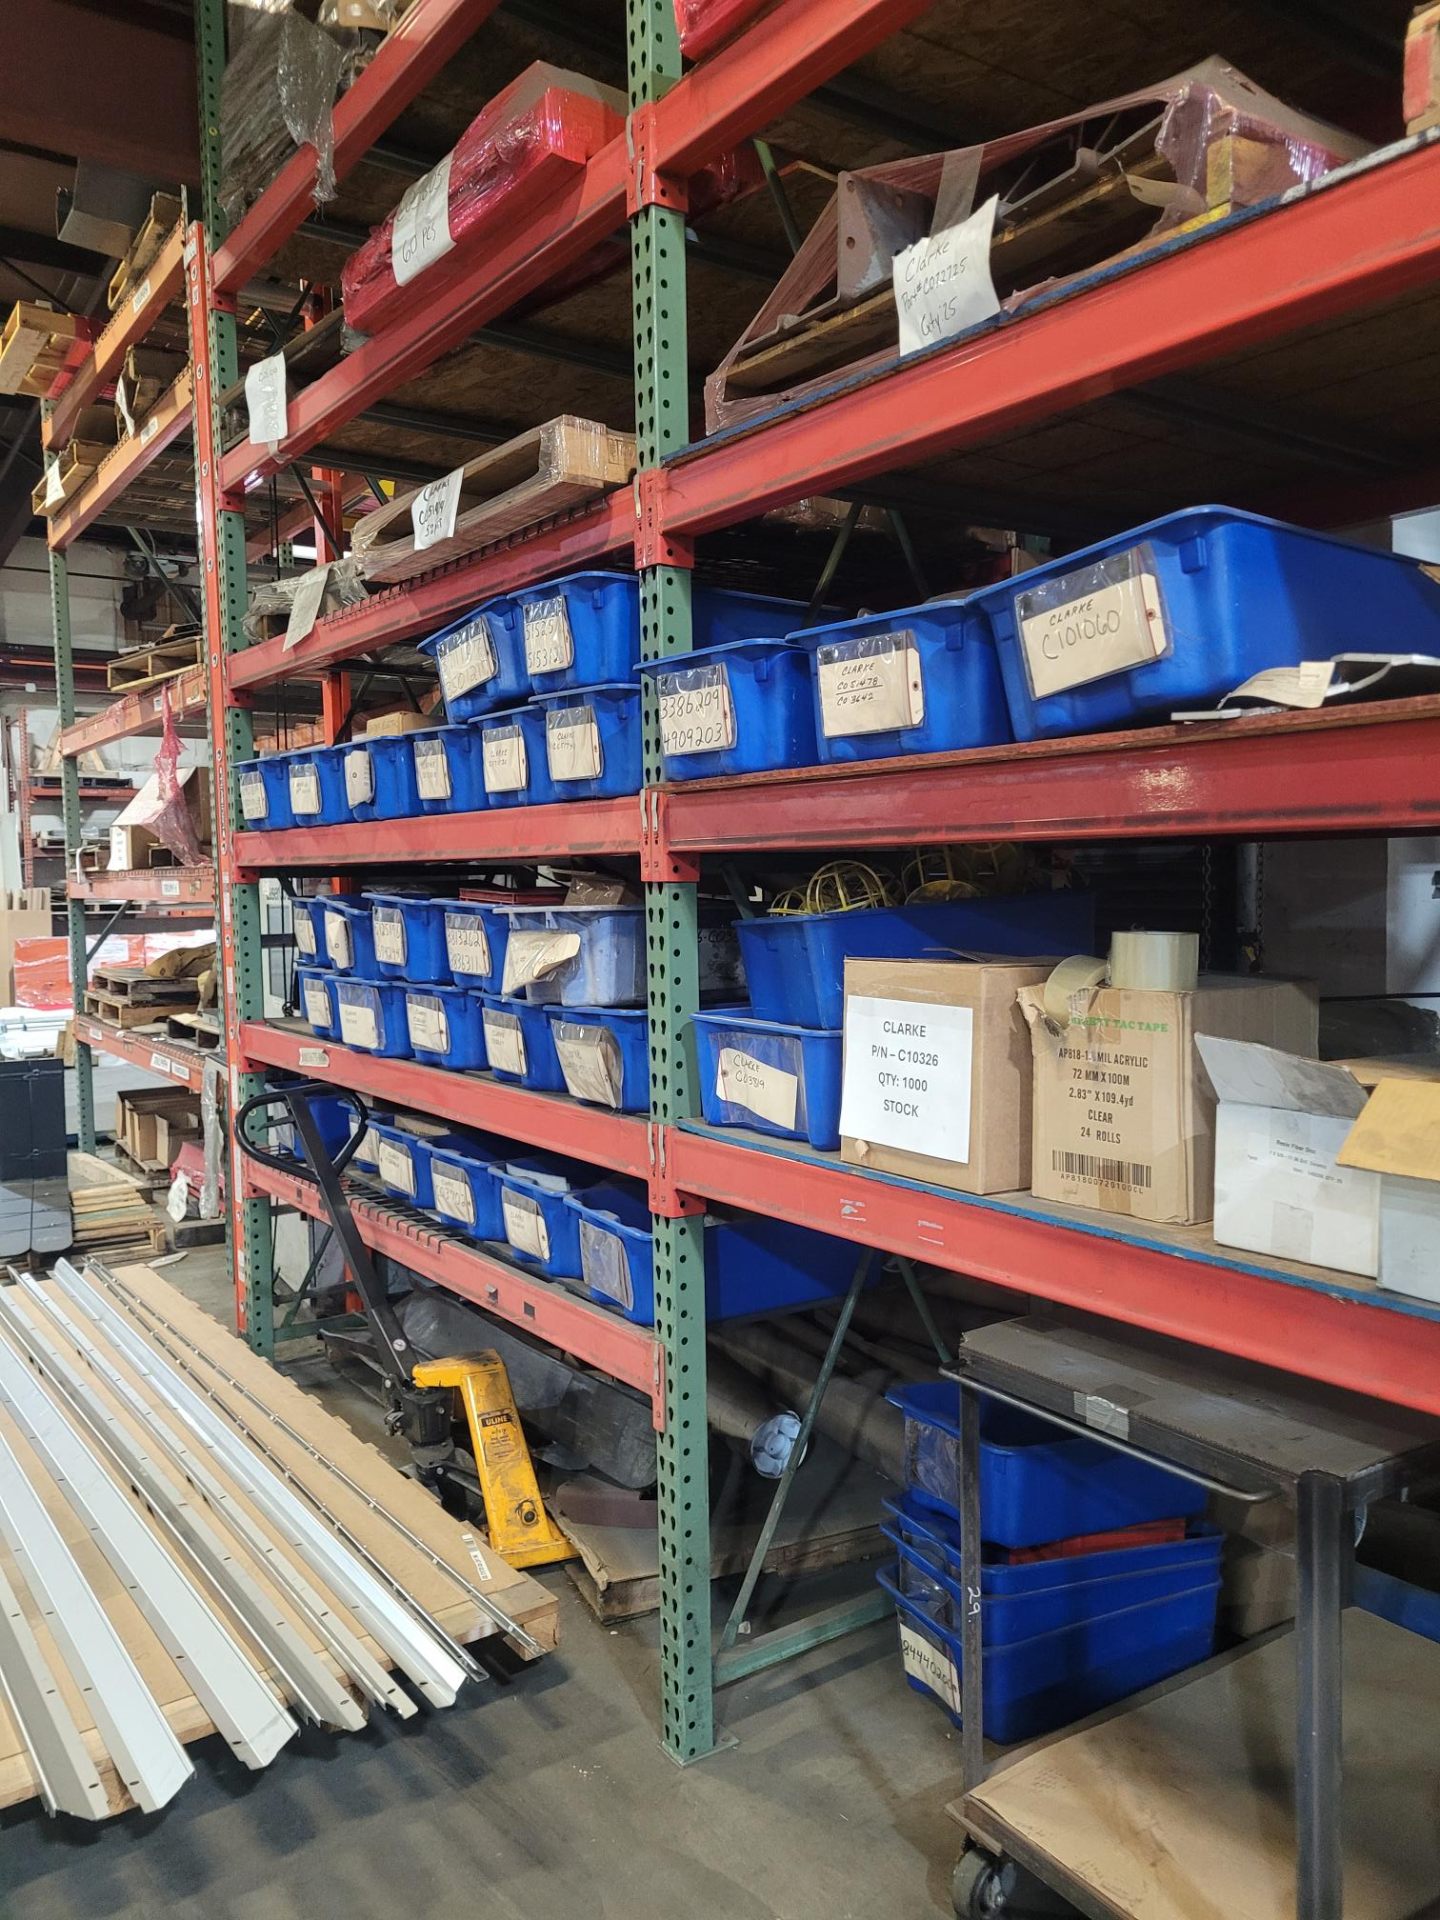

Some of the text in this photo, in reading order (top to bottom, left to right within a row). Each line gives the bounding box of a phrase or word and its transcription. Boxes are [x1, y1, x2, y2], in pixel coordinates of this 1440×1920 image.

[403, 235, 418, 263] 60
[905, 241, 951, 282] Clarke
[1049, 599, 1094, 626] CLARKE
[1042, 610, 1120, 660] C101060
[842, 662, 876, 676] CLARKE
[660, 688, 720, 720] 3386209
[663, 722, 723, 751] 4909203
[883, 1021, 927, 1038] CLARKE
[1137, 1022, 1169, 1033] TAPE
[871, 1044, 888, 1059] P/N
[898, 1049, 939, 1066] C10326
[1097, 1052, 1112, 1064] MIL
[1113, 1054, 1149, 1068] ACRYLIC
[878, 1071, 928, 1092] QTY: 1000
[1073, 1068, 1082, 1079] 72
[1085, 1070, 1099, 1081] MM
[883, 1099, 919, 1118] STOCK
[1088, 1109, 1113, 1124] CLEAR
[1080, 1126, 1121, 1144] 24 ROLLS
